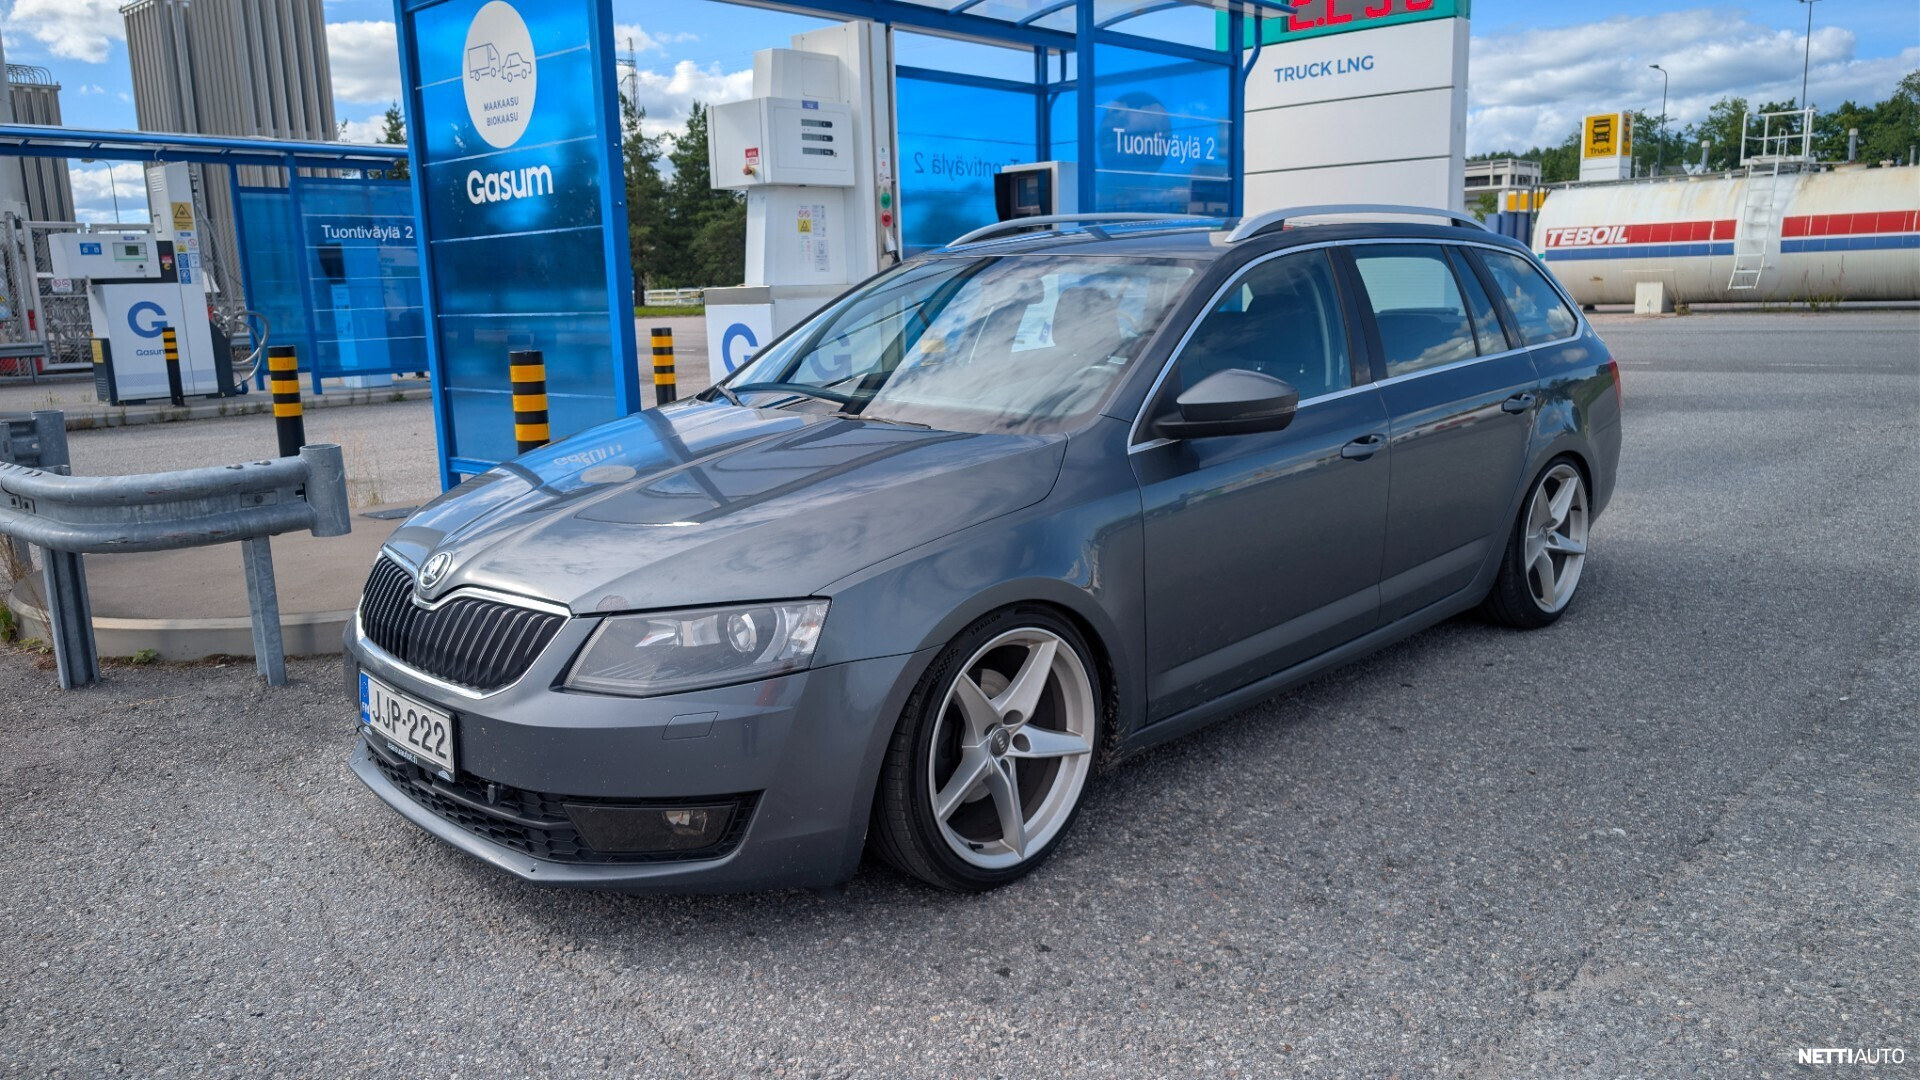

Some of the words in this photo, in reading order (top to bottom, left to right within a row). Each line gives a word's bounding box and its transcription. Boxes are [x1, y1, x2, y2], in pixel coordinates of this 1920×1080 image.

[1274, 60, 1332, 83] TRUCK
[1337, 55, 1374, 74] LNG
[483, 97, 519, 111] MAAKAASU
[486, 112, 519, 126] BIOKAASU
[1113, 128, 1200, 164] Tuontiväylä
[1206, 137, 1215, 160] 2
[467, 165, 554, 204] Gasum
[321, 224, 400, 241] Tuontiväylä
[404, 226, 414, 239] 2
[1547, 226, 1628, 246] TEBOIL
[372, 690, 447, 760] JJP-222
